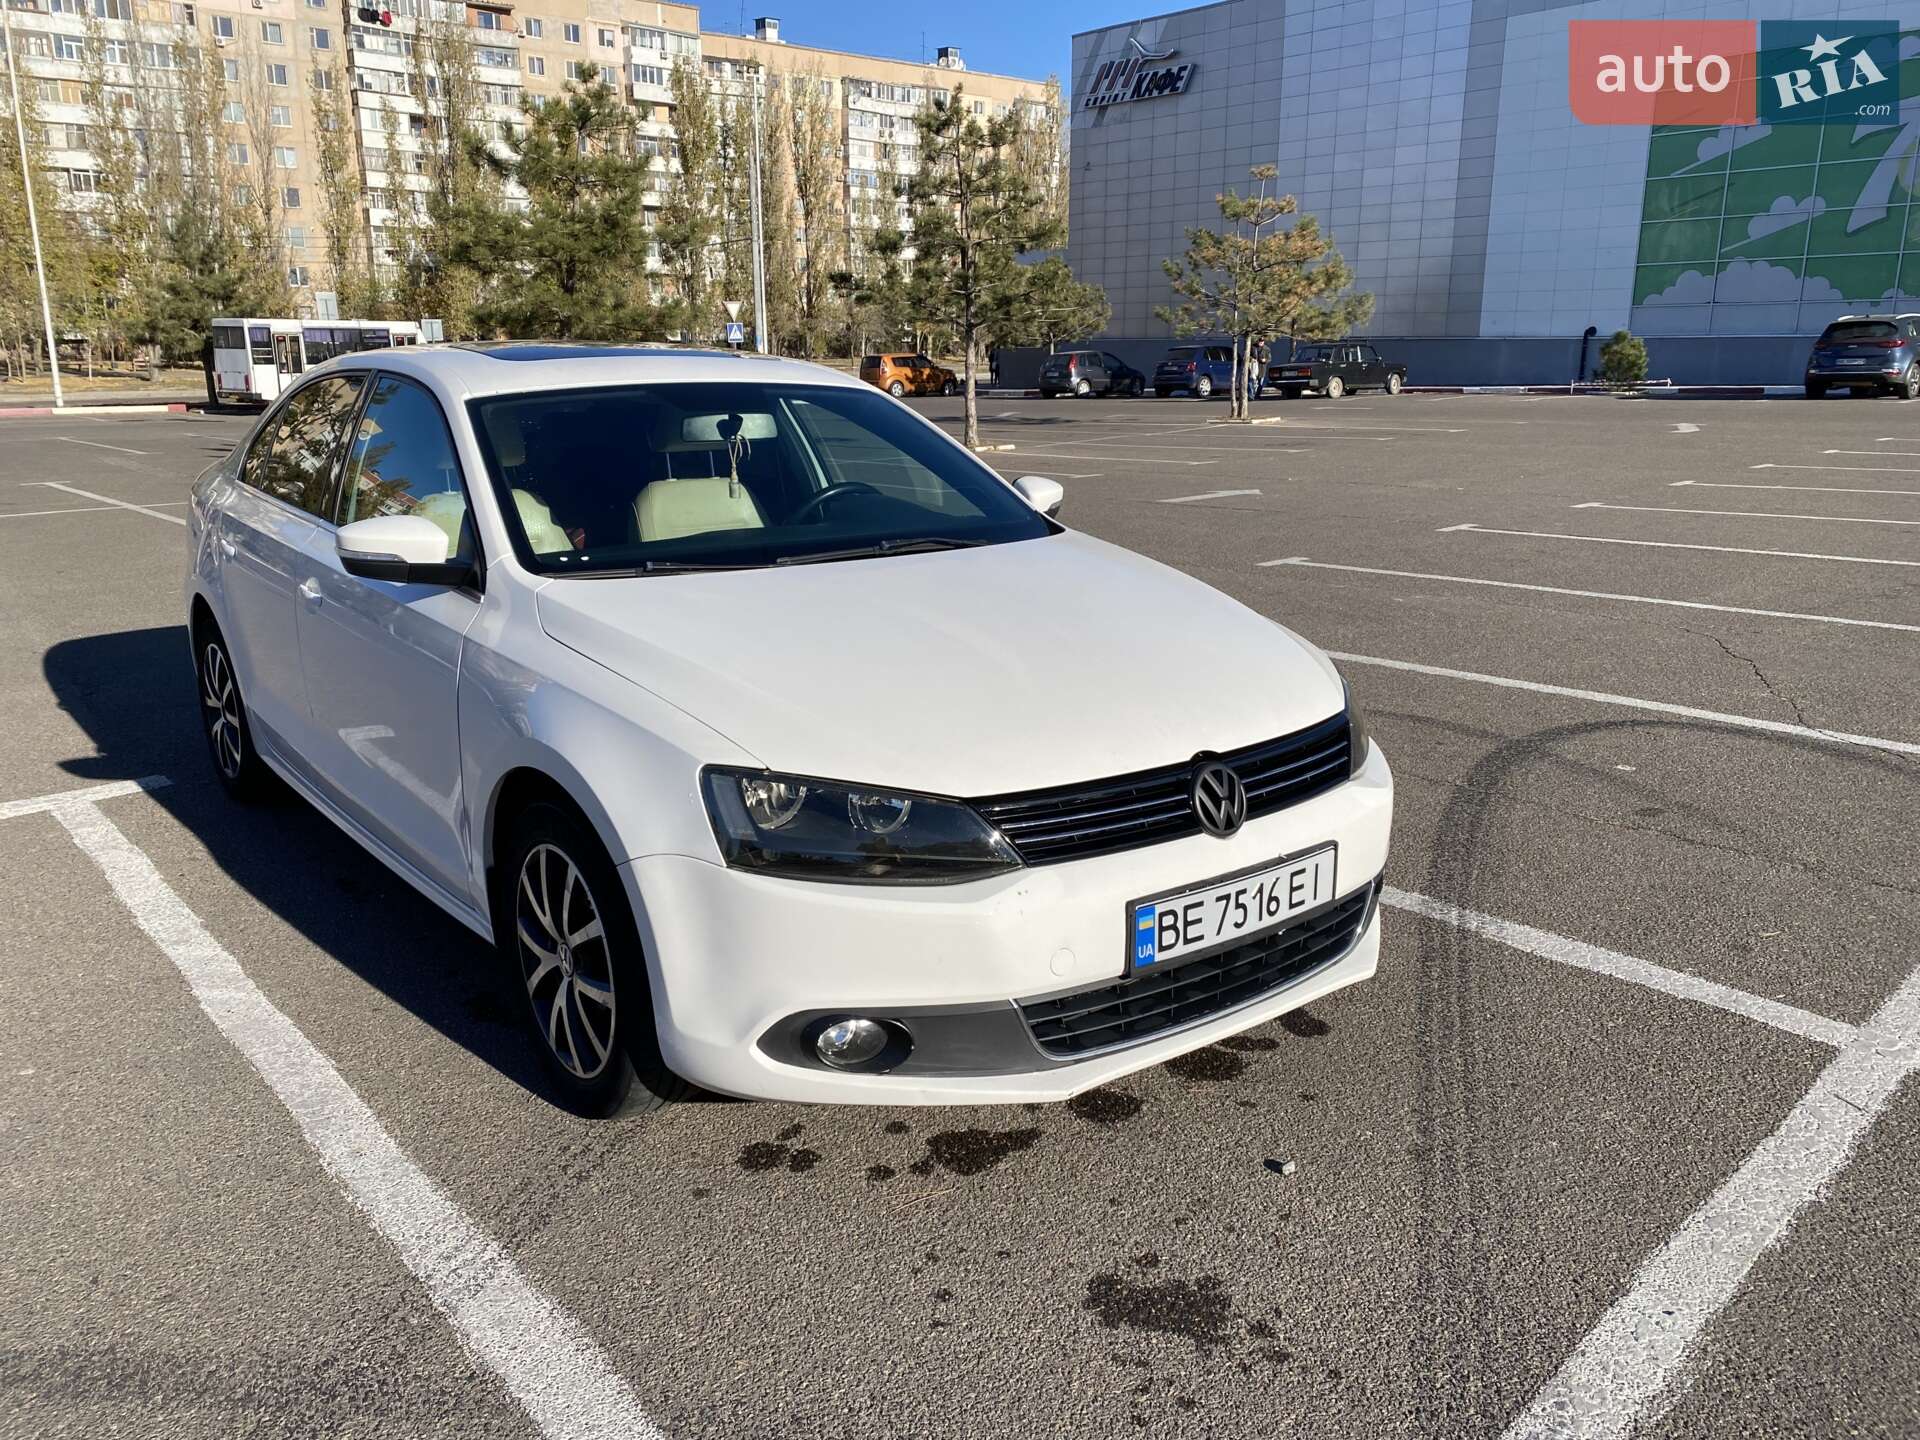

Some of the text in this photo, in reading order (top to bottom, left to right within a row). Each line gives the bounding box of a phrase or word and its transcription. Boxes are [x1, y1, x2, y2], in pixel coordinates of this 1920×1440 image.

[1131, 65, 1188, 99] КАФЕ
[1158, 863, 1319, 953] BE 7516 EI
[1138, 943, 1154, 958] UA
